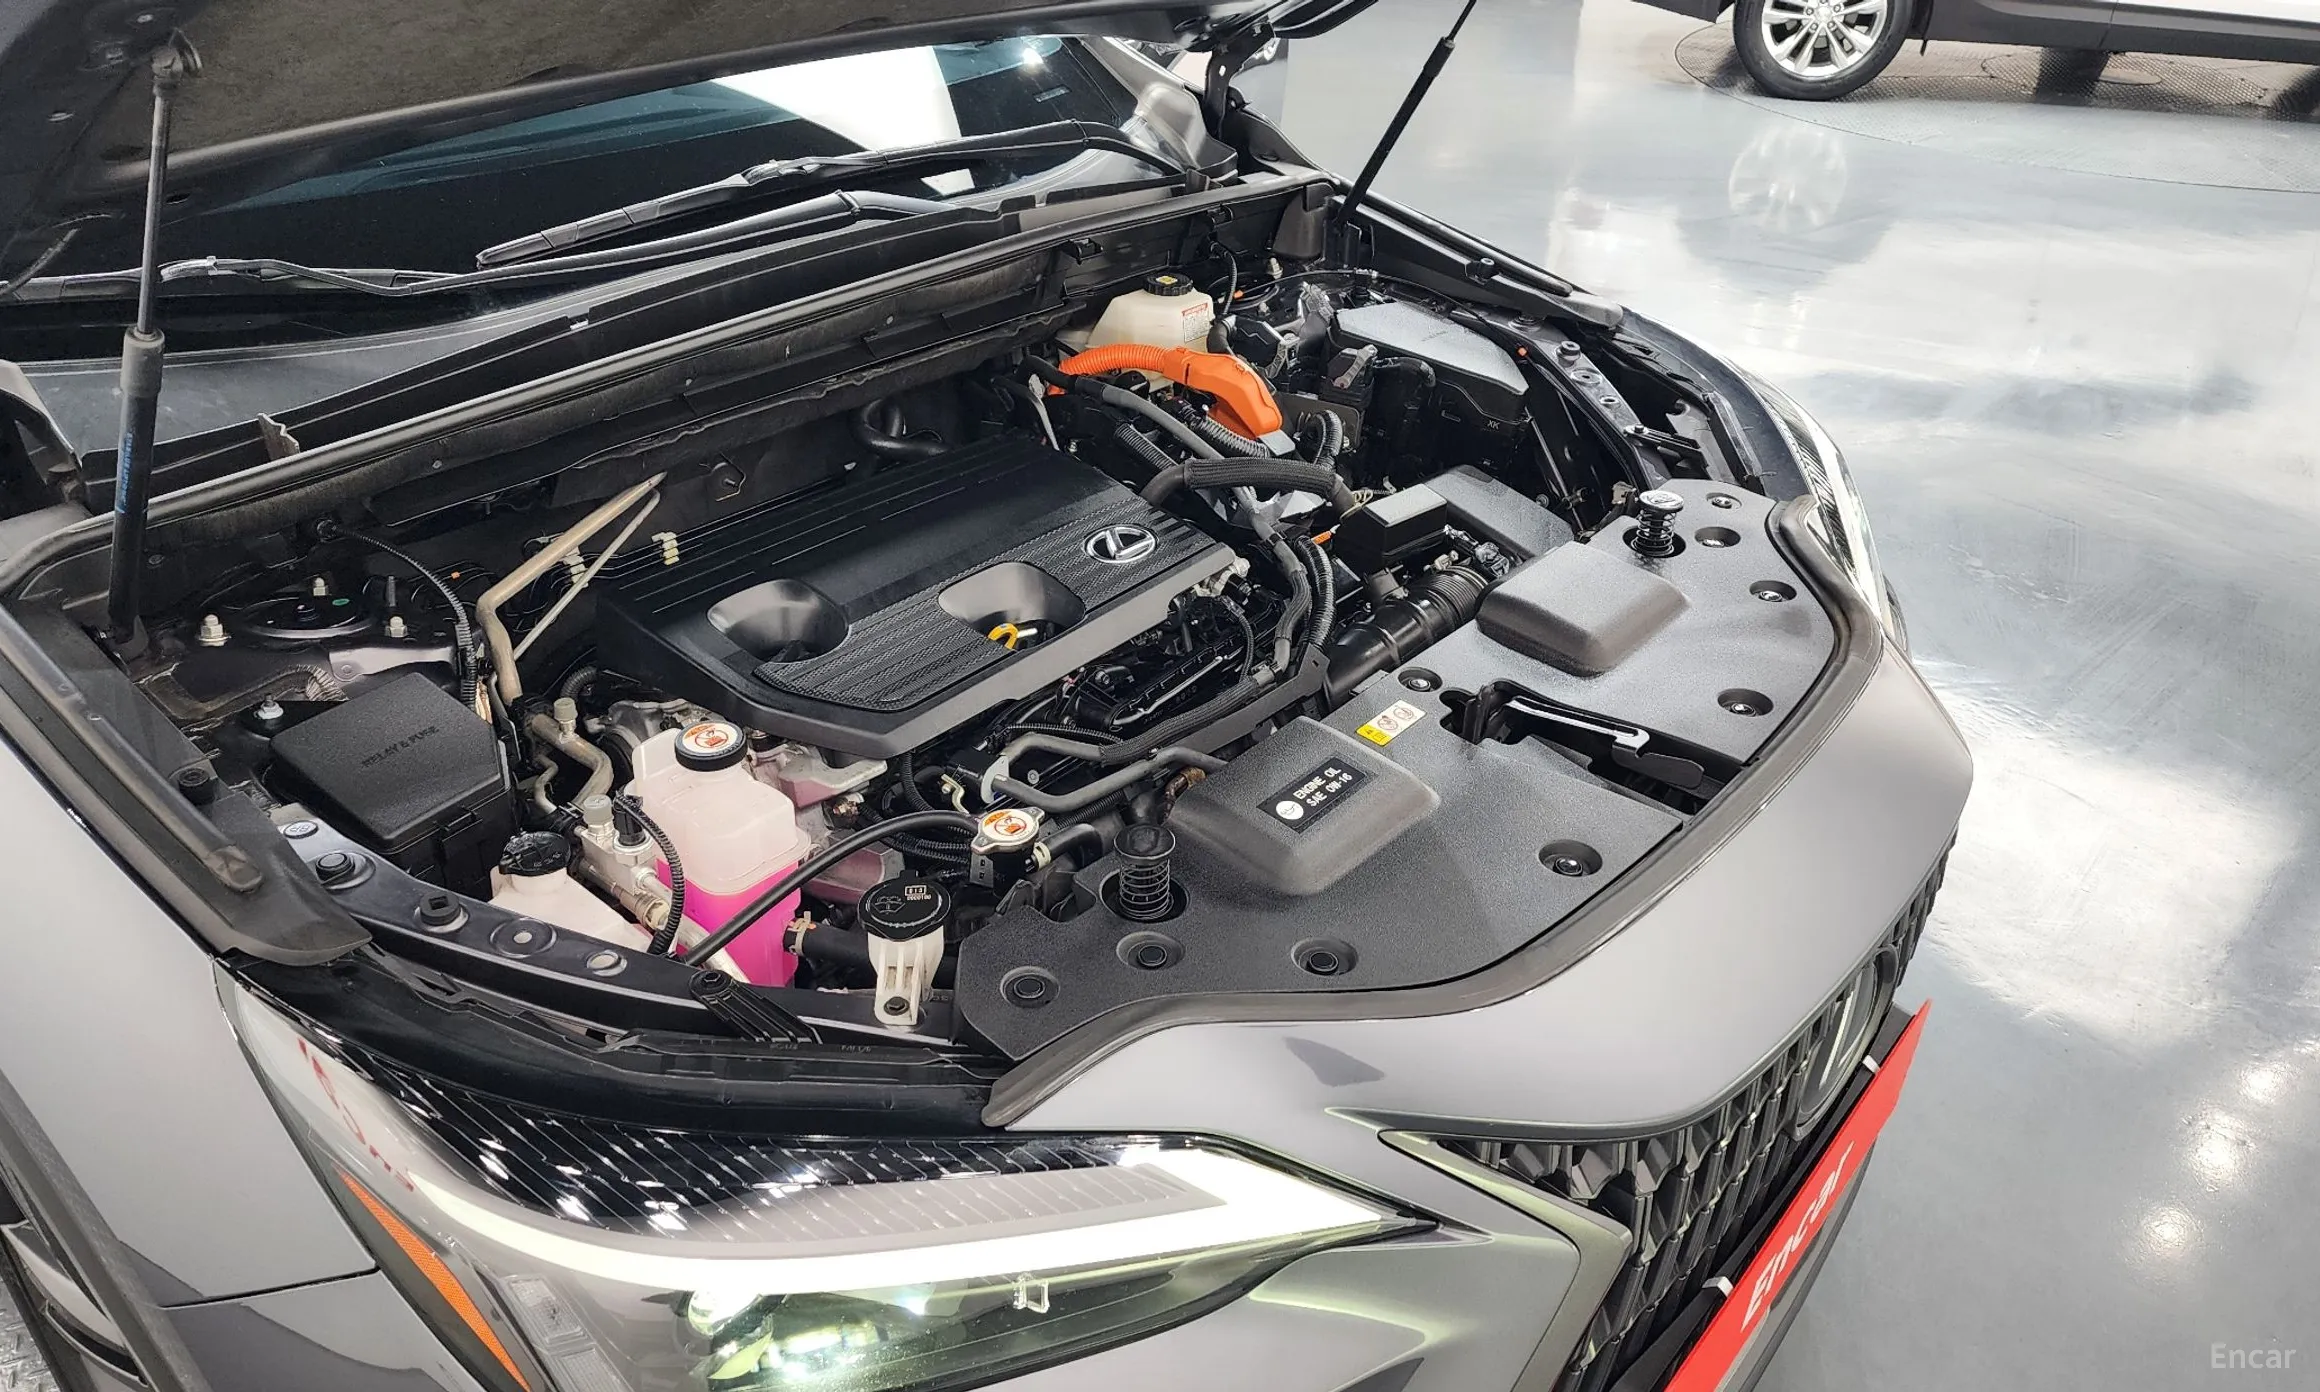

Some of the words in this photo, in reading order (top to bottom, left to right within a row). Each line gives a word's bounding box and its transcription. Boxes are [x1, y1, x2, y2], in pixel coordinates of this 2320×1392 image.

[361, 744, 399, 768] RELAY
[408, 725, 440, 743] FUSE
[1293, 776, 1326, 799] ENGINE
[1324, 767, 1341, 777] OIL
[1306, 791, 1327, 807] SAE
[1740, 1141, 1855, 1332] Encar
